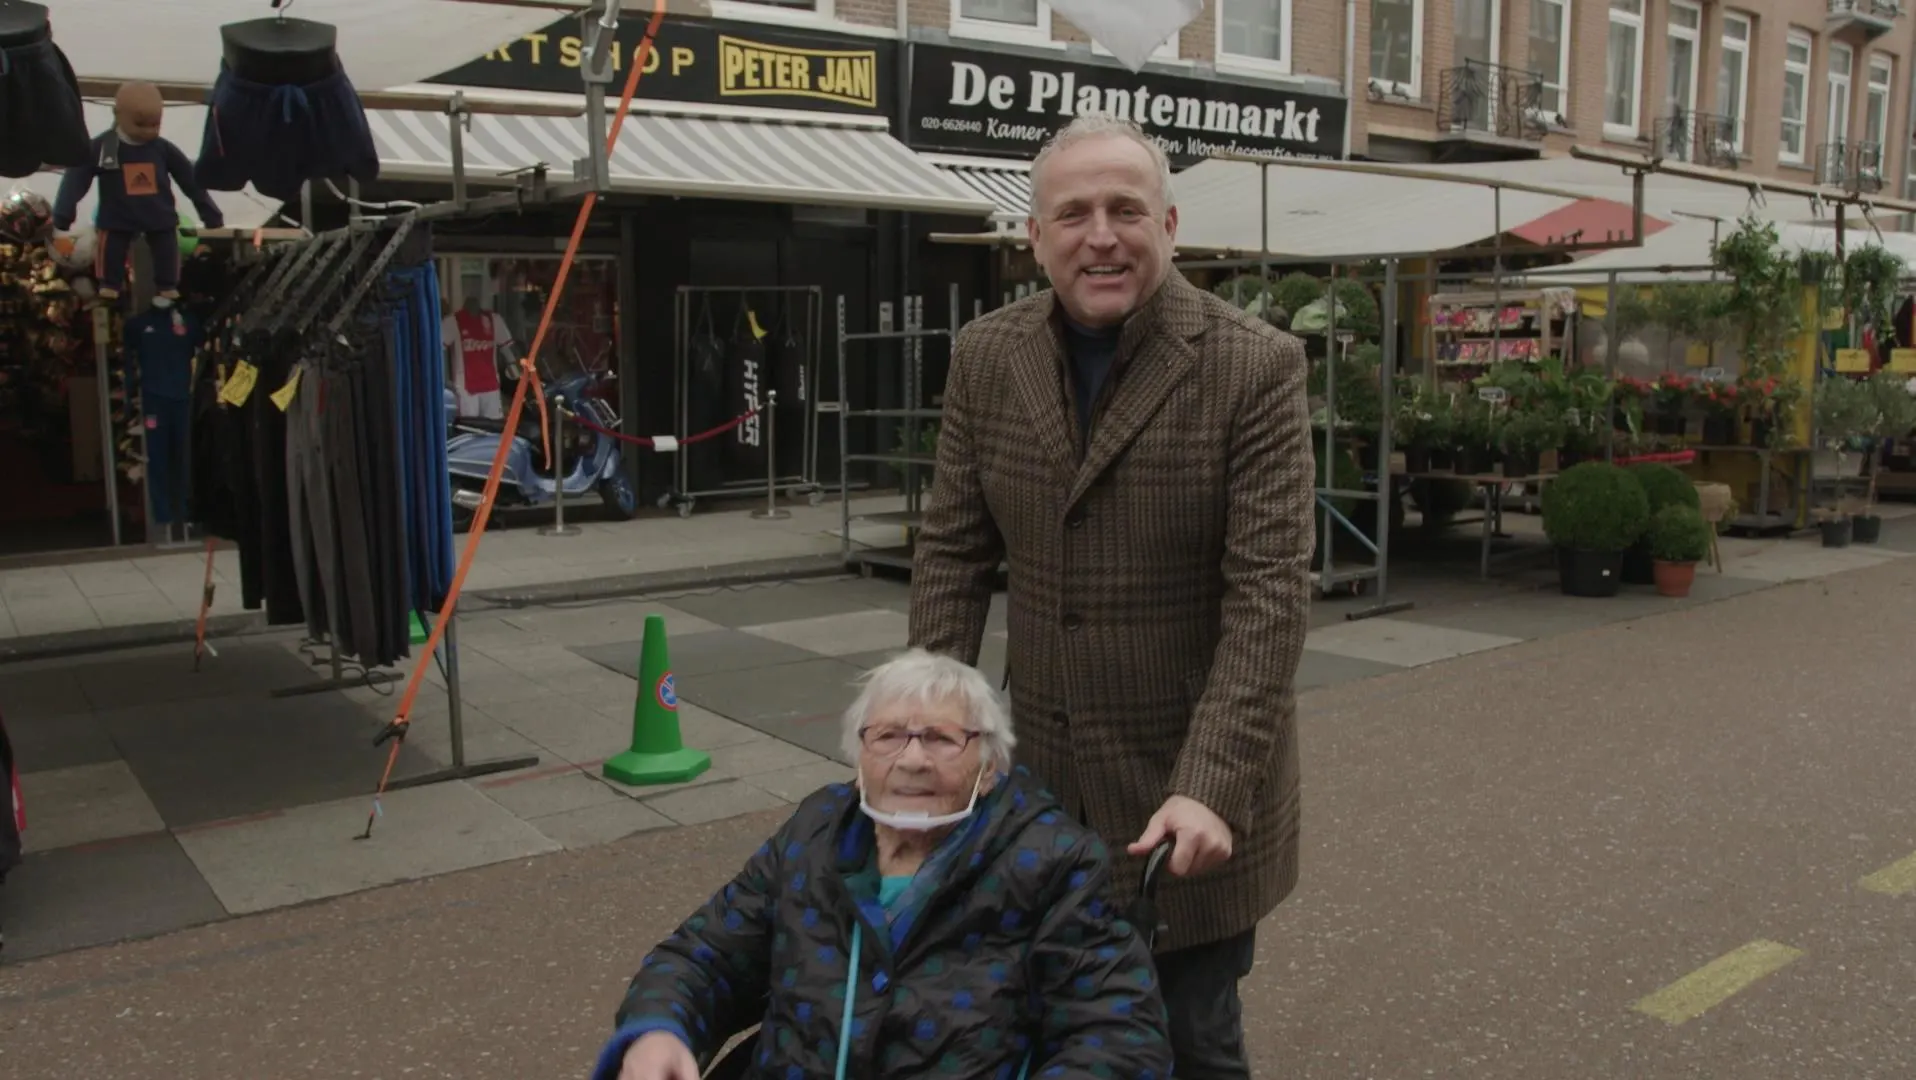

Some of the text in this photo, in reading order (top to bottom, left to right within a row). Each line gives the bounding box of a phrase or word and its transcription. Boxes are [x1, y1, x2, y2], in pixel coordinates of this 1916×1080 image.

[725, 45, 872, 98] PETER JAN
[949, 61, 1321, 143] De Plantenmarkt
[986, 117, 1051, 142] Kamer-
